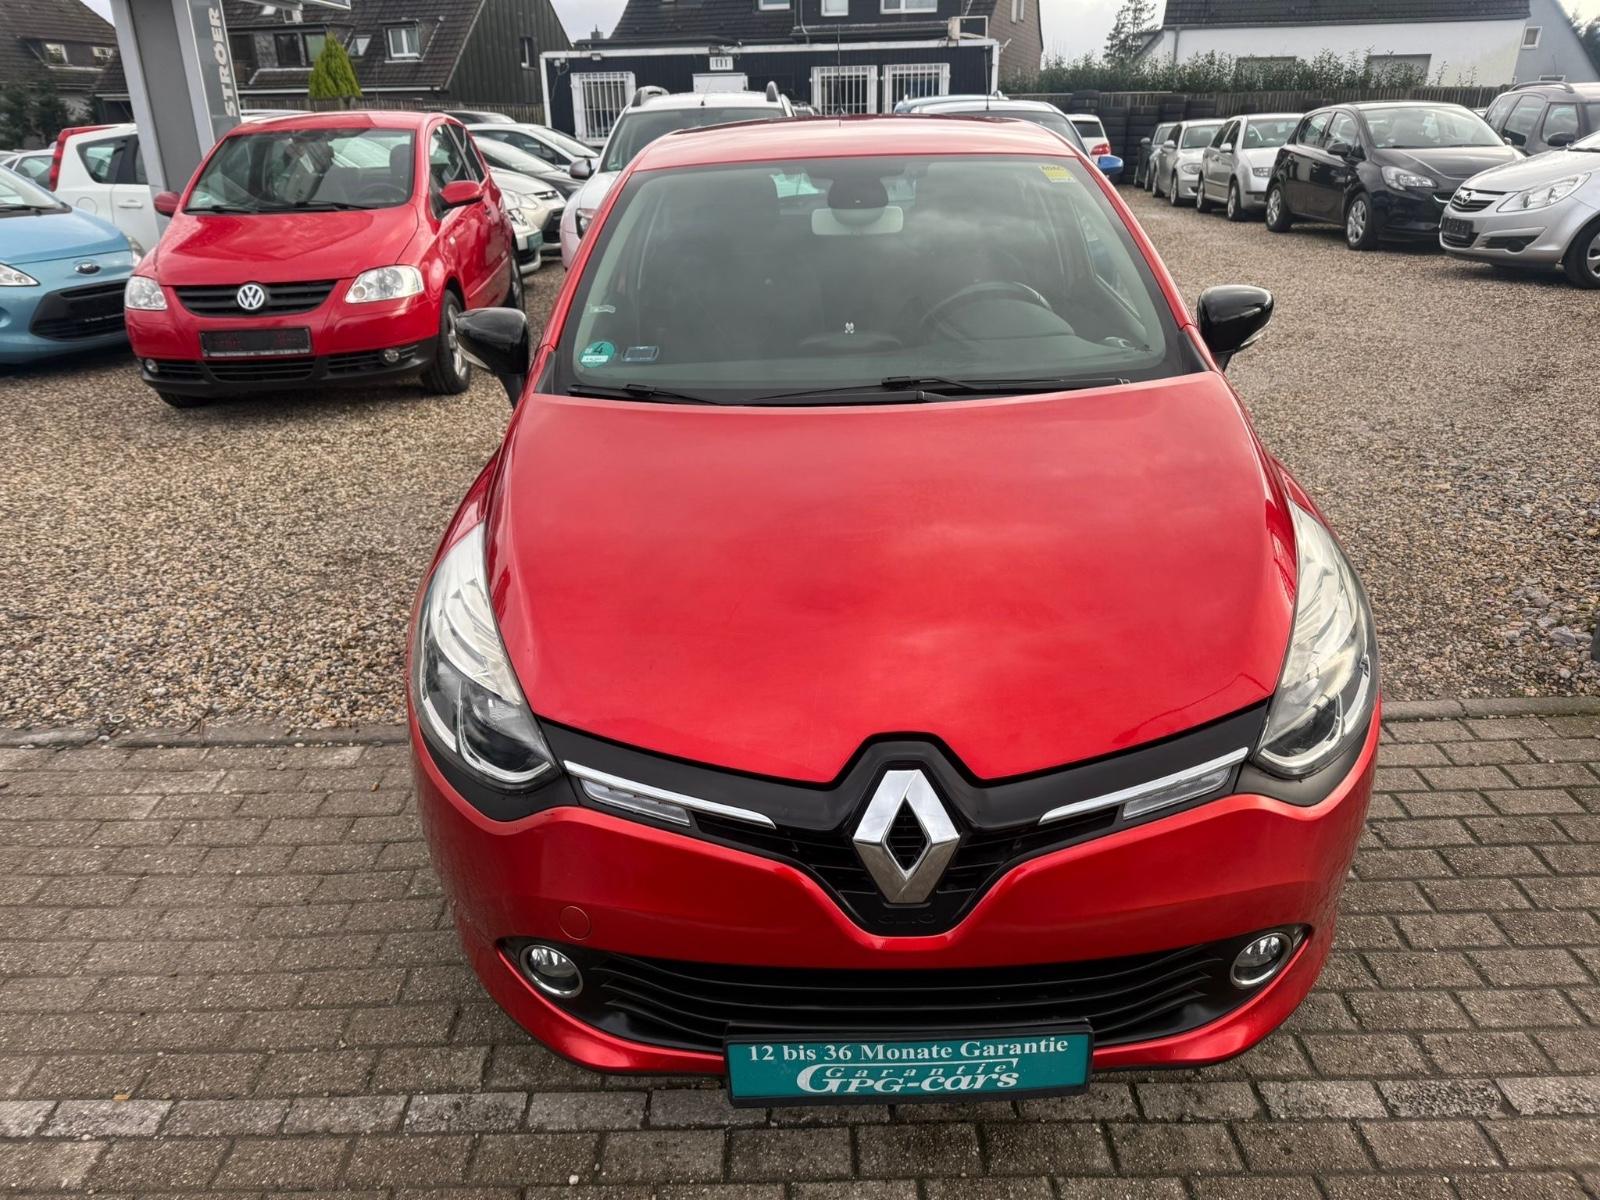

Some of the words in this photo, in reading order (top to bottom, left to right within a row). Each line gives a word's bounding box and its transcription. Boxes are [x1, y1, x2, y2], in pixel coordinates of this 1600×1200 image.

[592, 342, 606, 354] 4
[749, 1045, 775, 1061] 12
[783, 1045, 817, 1061] bis
[823, 1044, 852, 1061] 36
[860, 1043, 953, 1061] Monate
[960, 1037, 1069, 1057] Garantie
[796, 1063, 1020, 1093] GPG-cars
